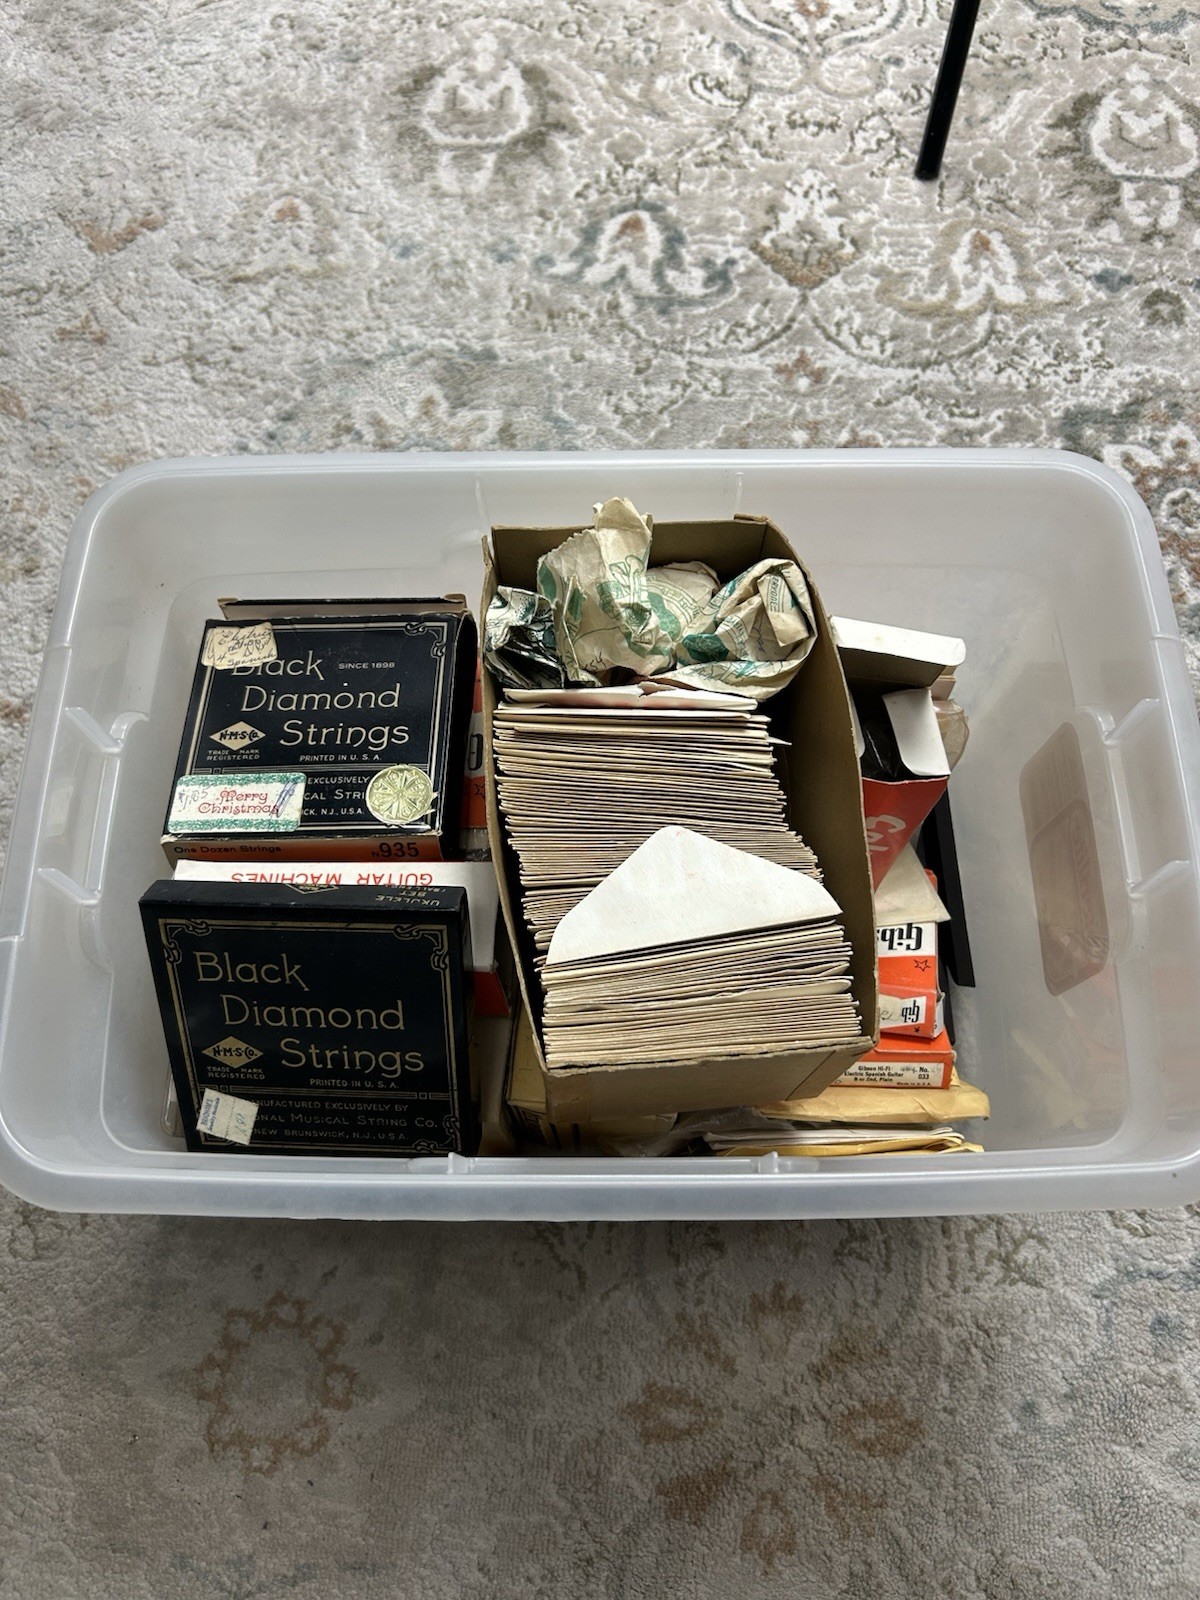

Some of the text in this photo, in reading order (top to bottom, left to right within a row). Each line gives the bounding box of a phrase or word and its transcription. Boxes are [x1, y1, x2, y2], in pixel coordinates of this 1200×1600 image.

[338, 662, 369, 670] SINCE
[371, 661, 396, 669] 1898
[241, 682, 401, 712] Diamond
[279, 719, 410, 751] Strings
[300, 754, 335, 762] PRINTED
[307, 775, 371, 785] EXCLUSIVELY
[220, 789, 269, 805] Merry
[334, 788, 365, 800] STRI
[198, 801, 280, 816] Christmas
[174, 846, 198, 854] One
[240, 845, 282, 853] Strings
[231, 872, 433, 887] GUITAR MACHINES
[375, 895, 440, 906] UKULELE
[192, 951, 310, 992] Black
[220, 993, 405, 1031] Diamond
[279, 1037, 425, 1079] Strings
[208, 1072, 266, 1080] REGISTERED
[310, 1079, 348, 1088] PRINTED
[351, 1080, 361, 1088] IN
[257, 1099, 409, 1113] NUFACTURED EXCLUSIVELY BY
[255, 1114, 286, 1123] ONAL
[254, 1127, 278, 1136] NEW
